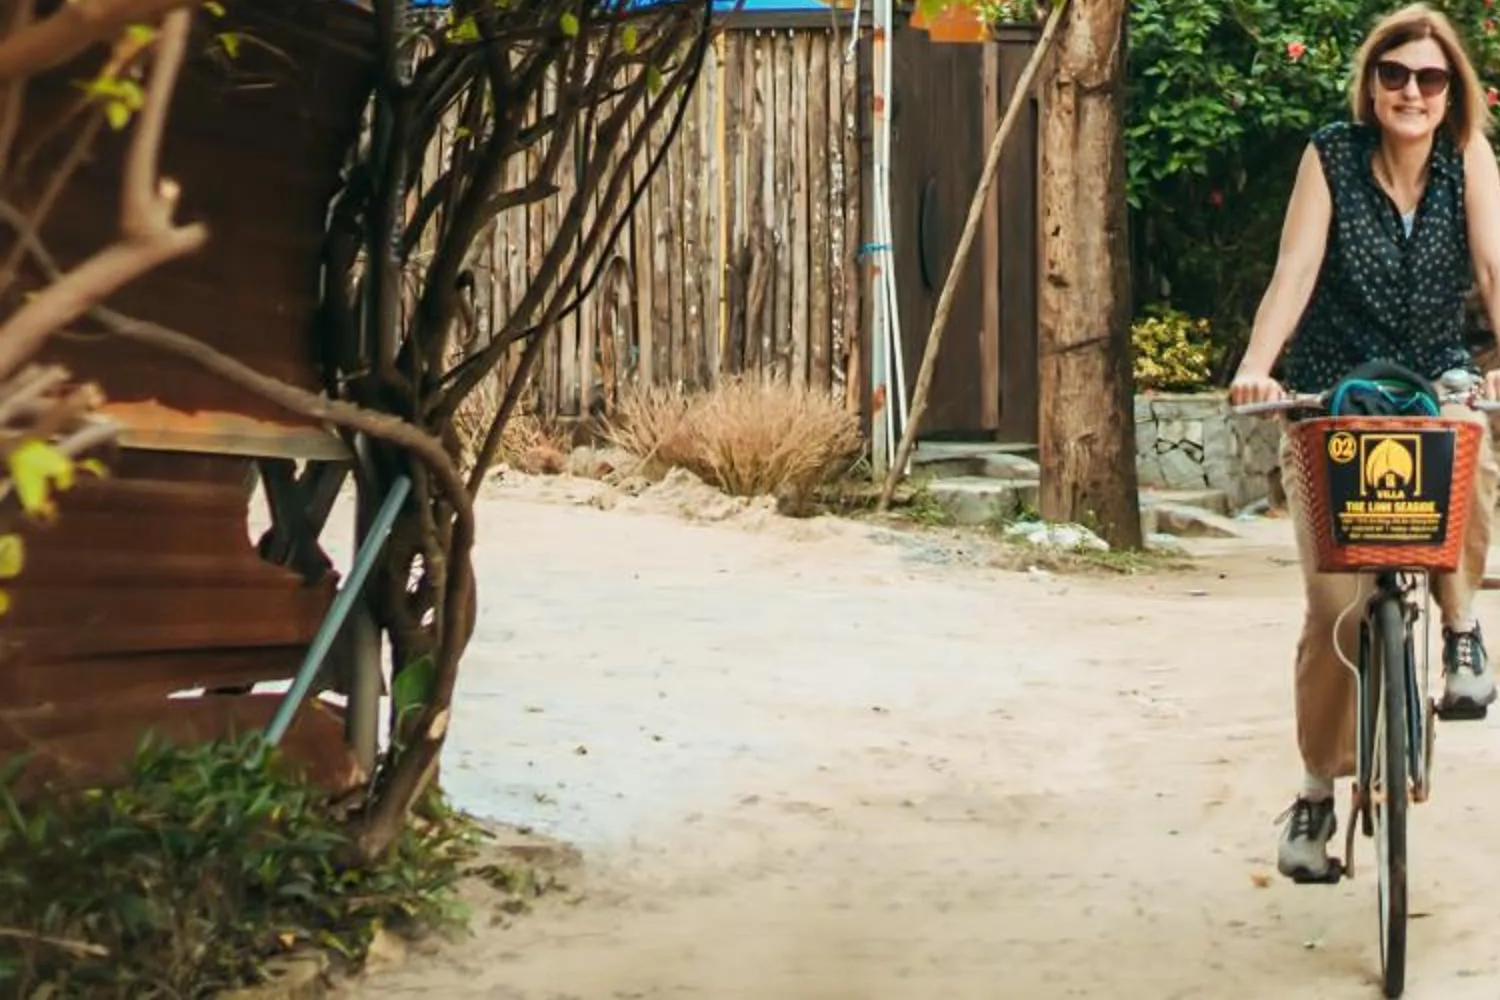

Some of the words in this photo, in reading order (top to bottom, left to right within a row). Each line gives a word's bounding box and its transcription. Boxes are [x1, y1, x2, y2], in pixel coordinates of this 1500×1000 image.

[1332, 437, 1354, 457] 02
[1377, 489, 1405, 499] VILLA
[1346, 501, 1365, 512] THE
